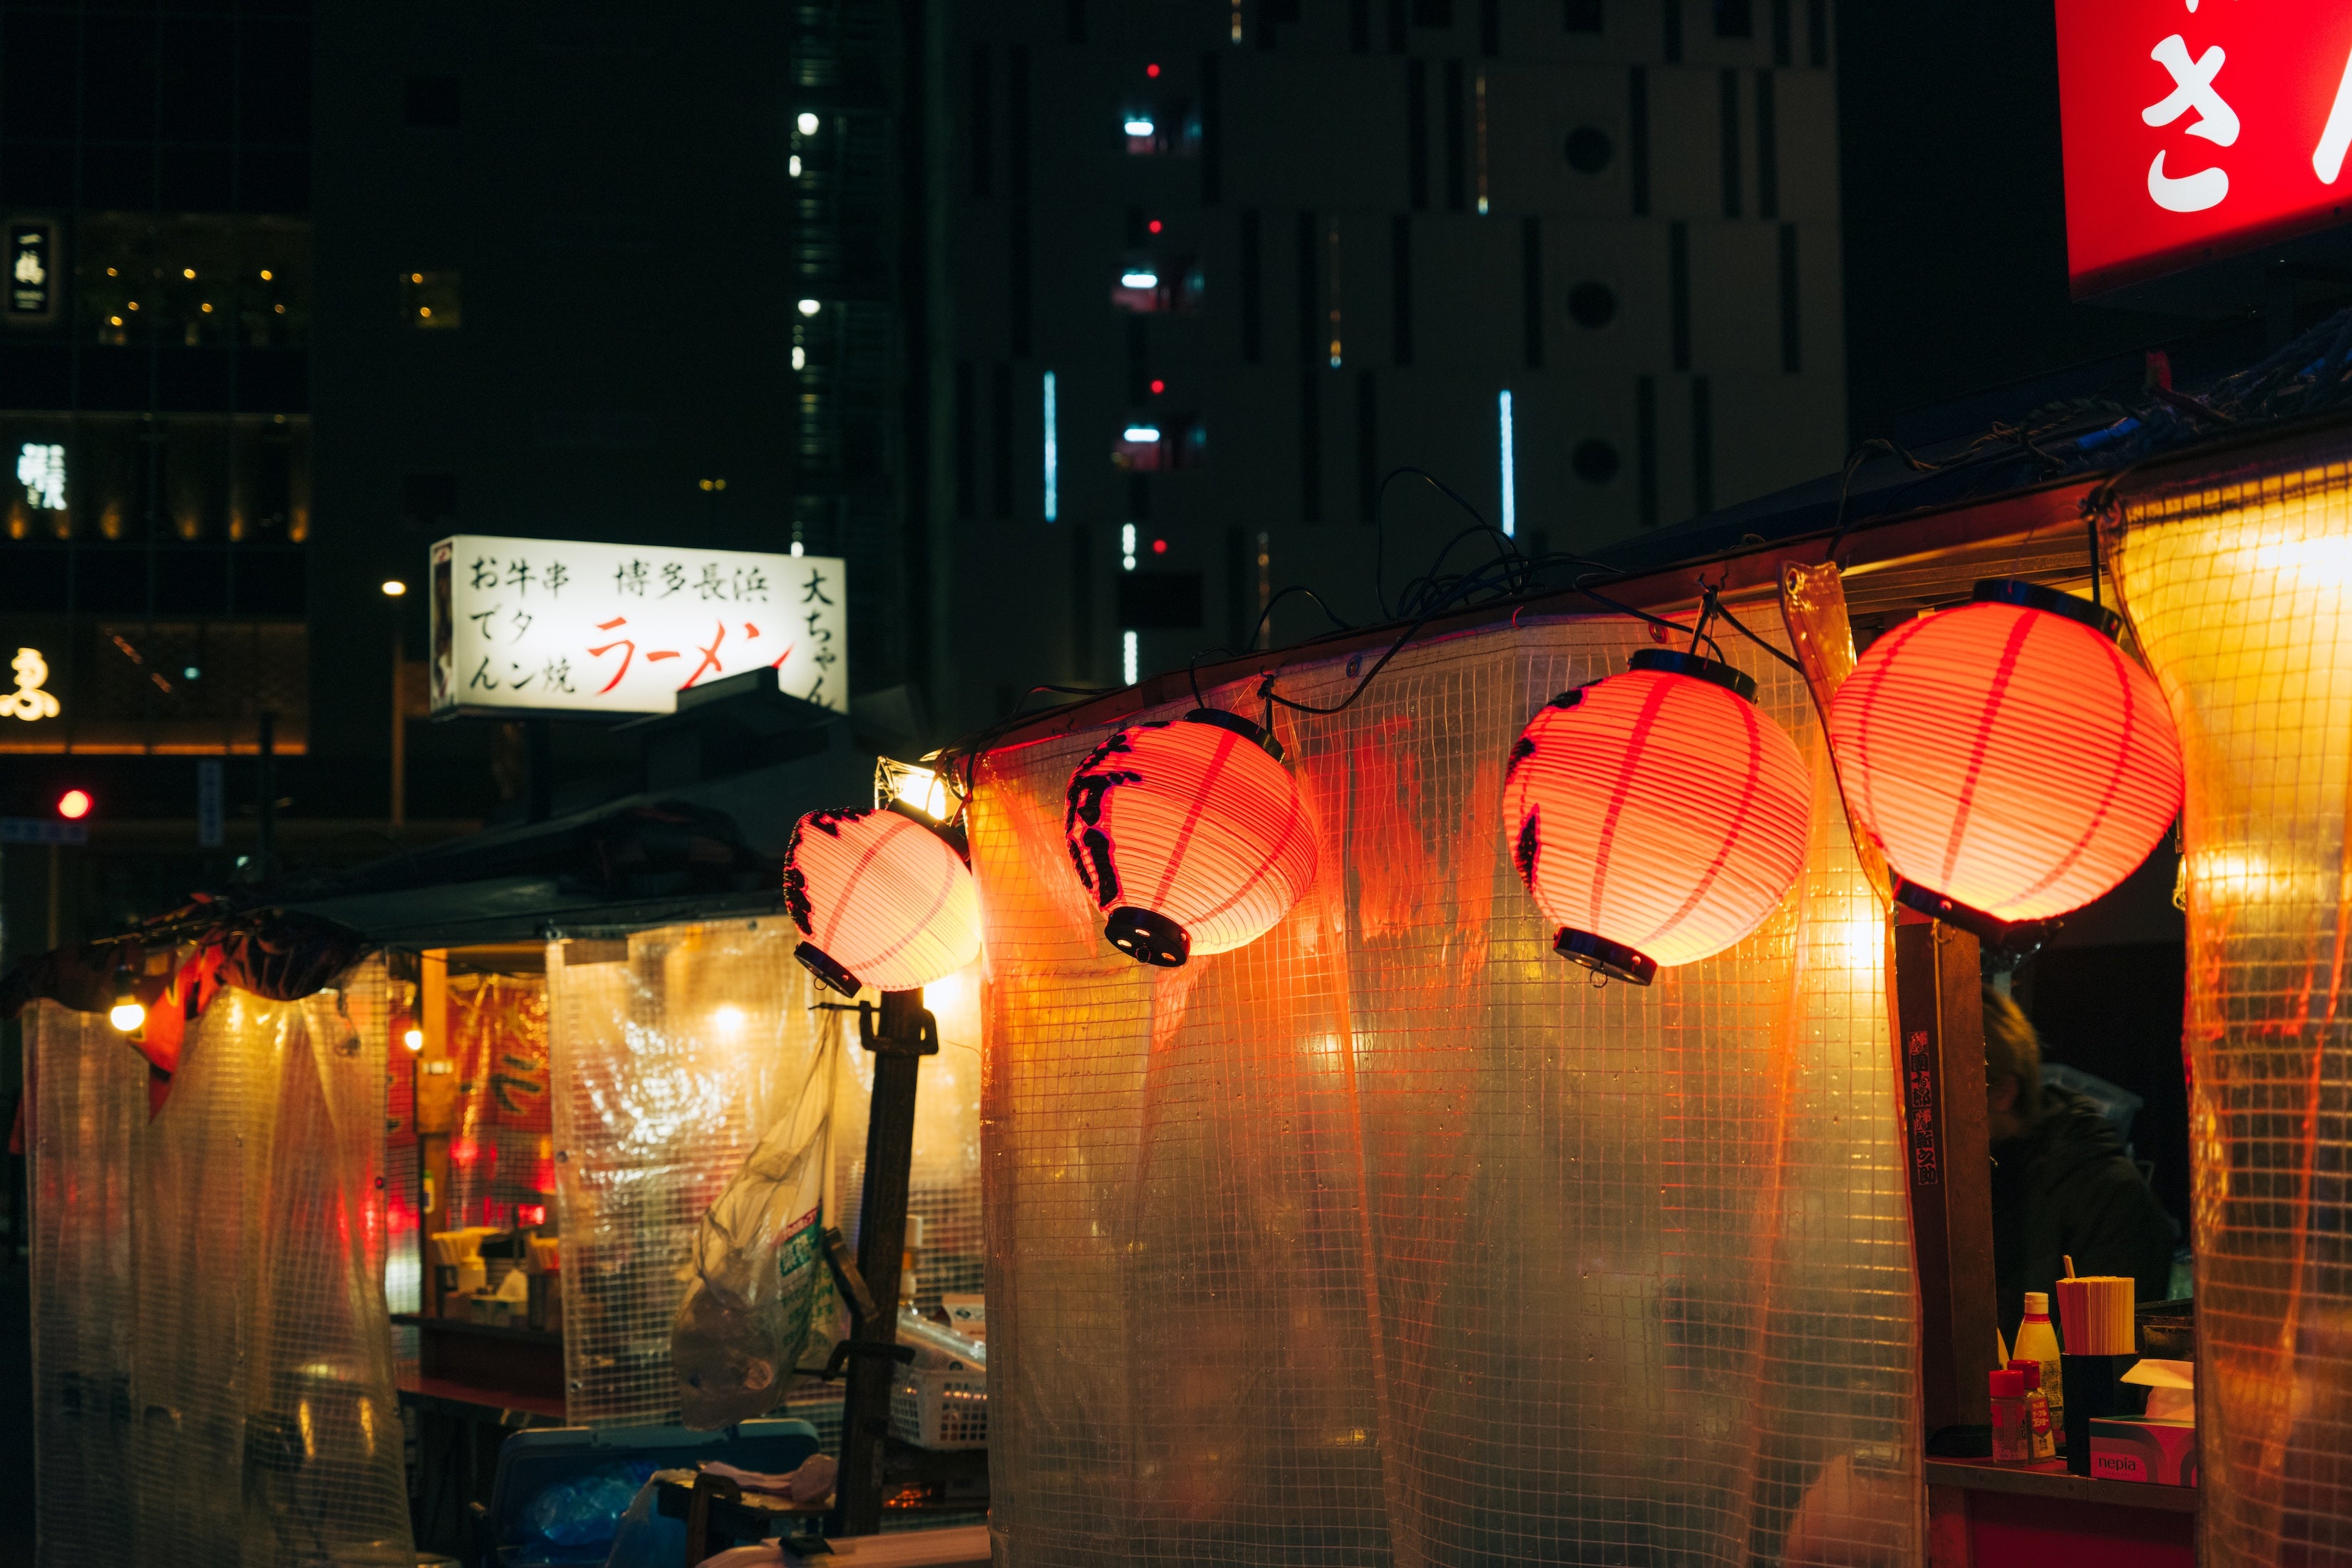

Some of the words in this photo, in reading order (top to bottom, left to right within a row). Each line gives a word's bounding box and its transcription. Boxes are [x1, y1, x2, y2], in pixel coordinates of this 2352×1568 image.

[2142, 0, 2240, 212] さ
[470, 557, 500, 690] おでん
[505, 559, 537, 690] 牛タン
[542, 561, 576, 694] 串焼
[614, 557, 770, 603] 博多長浜
[802, 567, 836, 710] 大ちゃん
[587, 616, 795, 696] ラーメン
[2099, 1457, 2136, 1471] nepia
